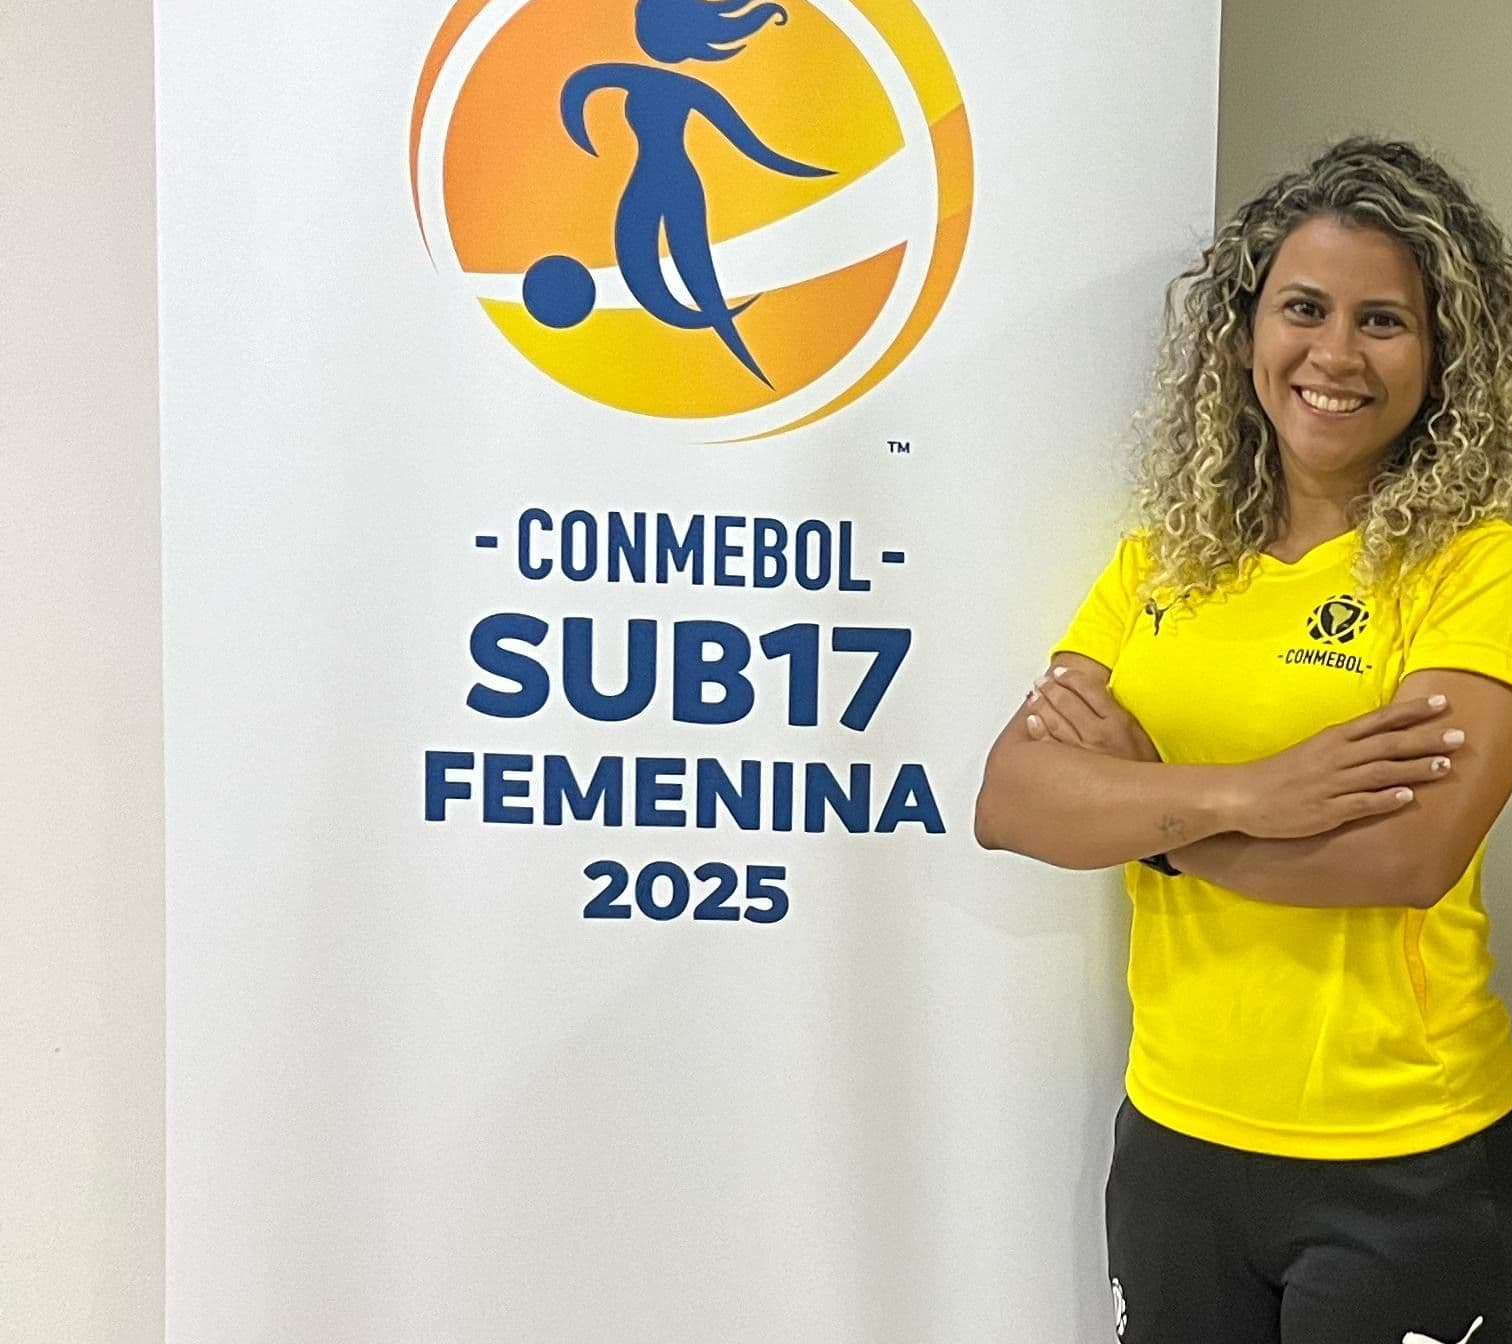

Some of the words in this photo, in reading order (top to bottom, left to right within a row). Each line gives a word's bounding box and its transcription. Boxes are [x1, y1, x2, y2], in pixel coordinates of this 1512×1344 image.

[886, 440, 911, 454] TM
[465, 612, 912, 732] SUB17
[424, 750, 947, 835] FEMENINA
[582, 859, 790, 924] 2025
